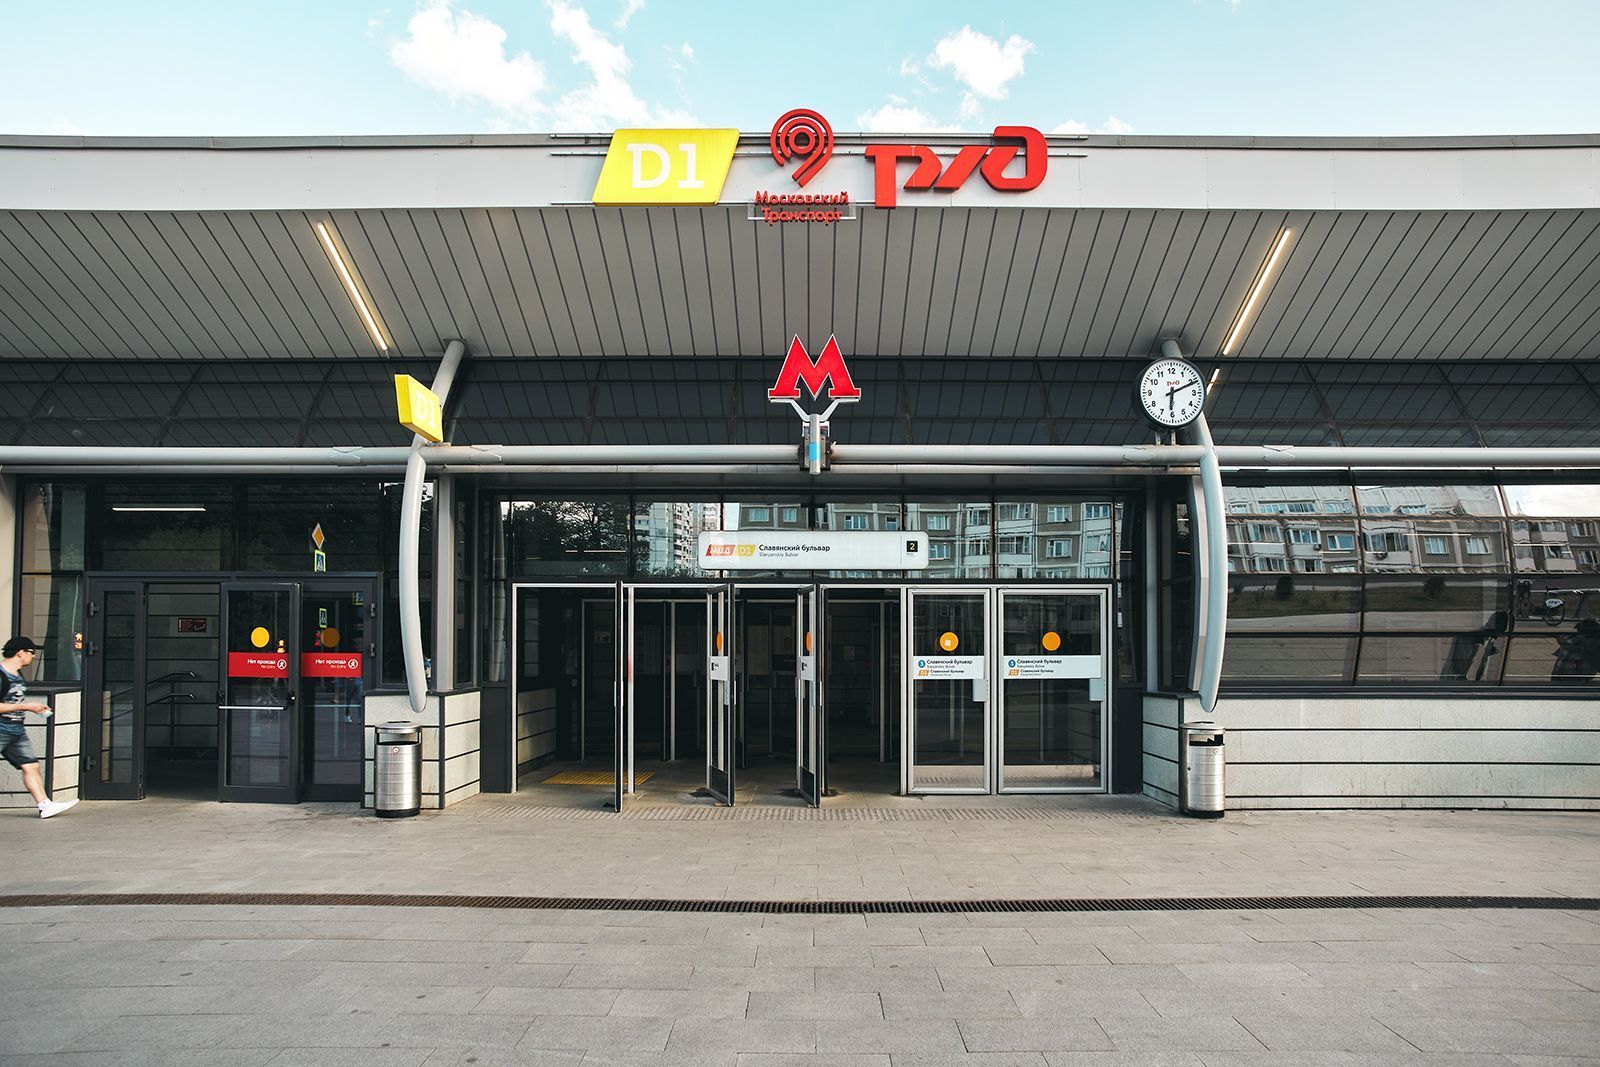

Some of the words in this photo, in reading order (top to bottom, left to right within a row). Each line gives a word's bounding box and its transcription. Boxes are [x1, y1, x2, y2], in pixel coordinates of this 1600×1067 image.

[626, 143, 704, 189] D1
[755, 190, 849, 205] Московский
[761, 207, 842, 227] Транспорт
[768, 333, 861, 400] М
[758, 544, 801, 552] Славянский
[801, 544, 831, 553] бульвар
[909, 542, 916, 551] 2
